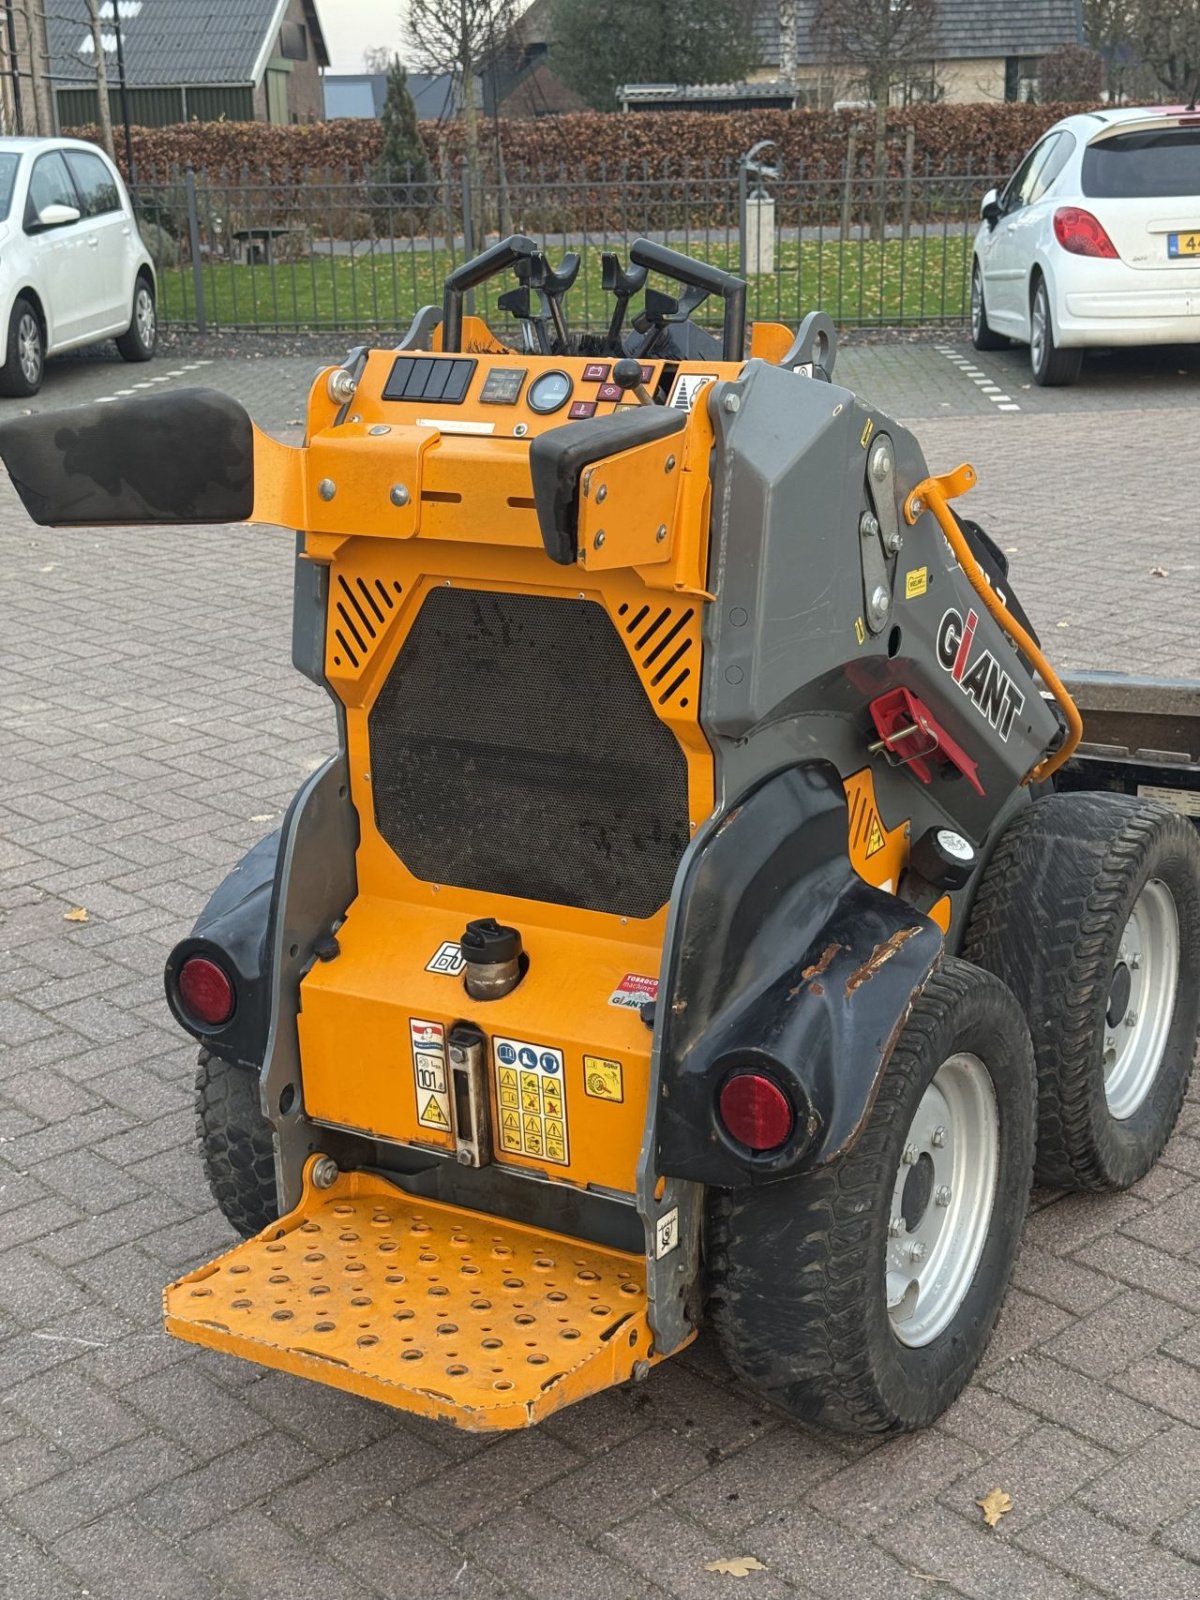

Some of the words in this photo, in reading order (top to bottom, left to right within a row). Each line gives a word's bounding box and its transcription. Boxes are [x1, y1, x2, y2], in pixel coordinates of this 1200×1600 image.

[1186, 236, 1200, 251] 4
[627, 976, 659, 986] TOBROCO
[419, 1069, 436, 1089] 101
